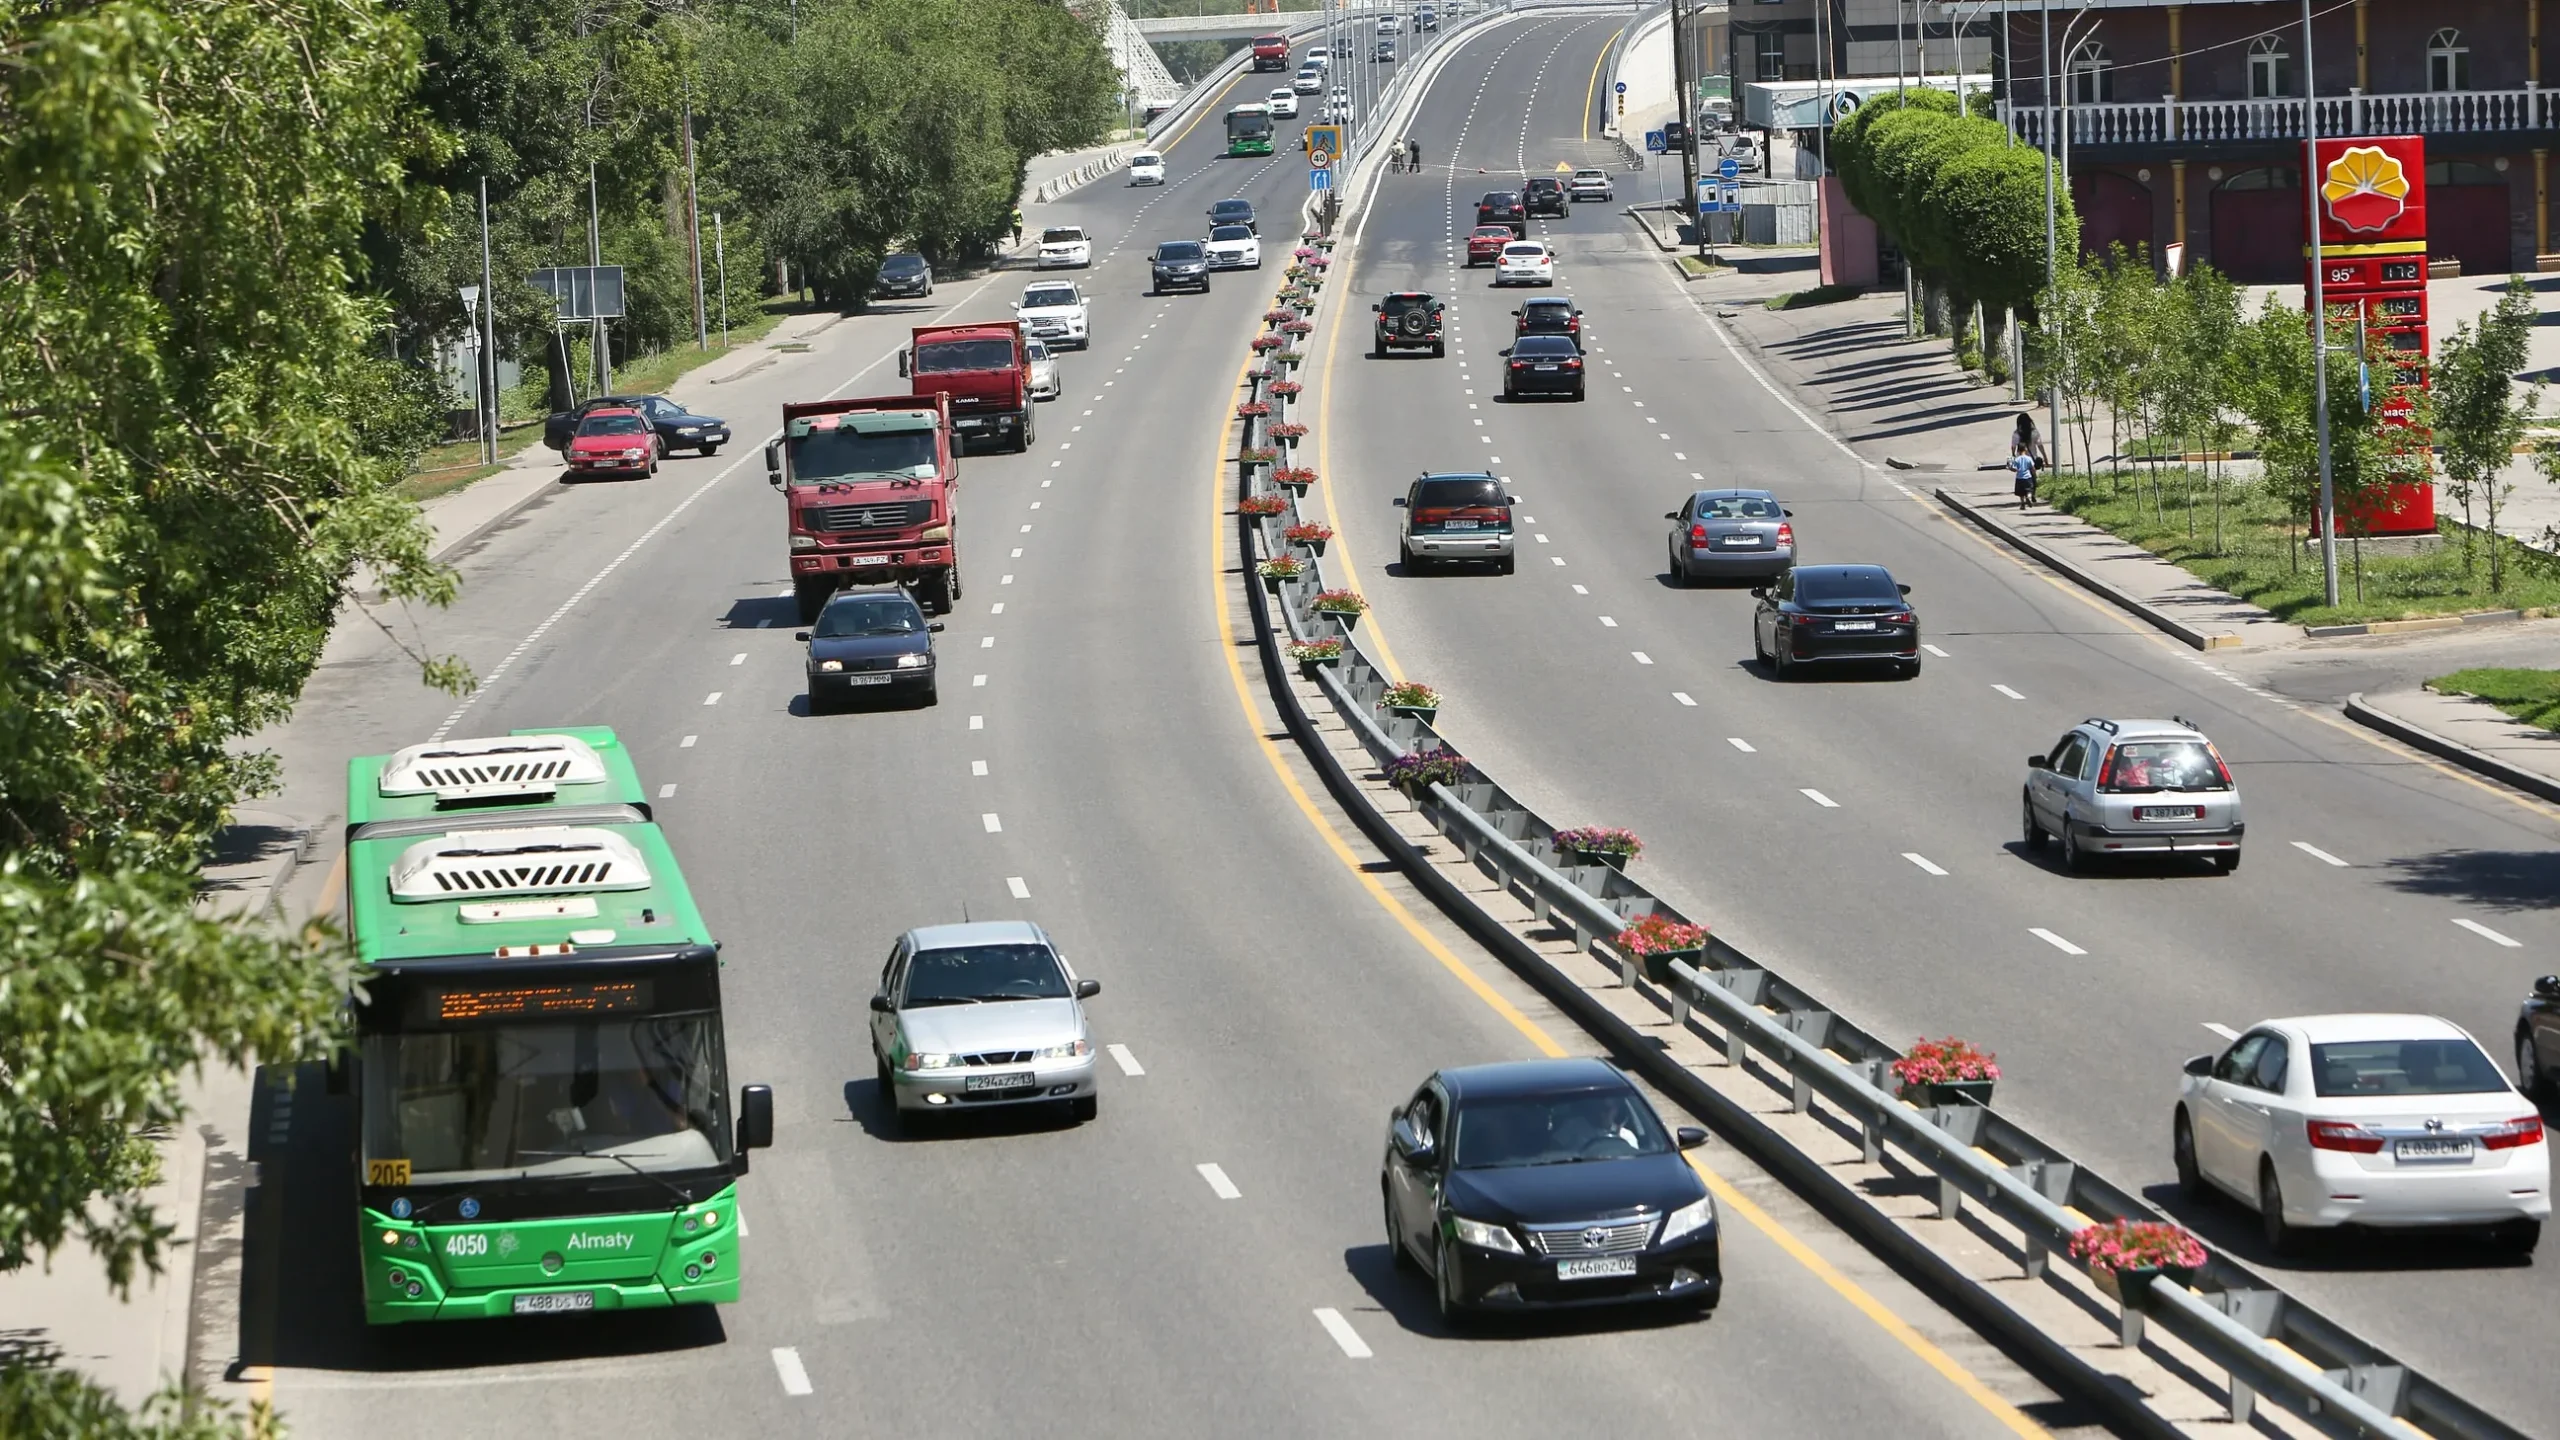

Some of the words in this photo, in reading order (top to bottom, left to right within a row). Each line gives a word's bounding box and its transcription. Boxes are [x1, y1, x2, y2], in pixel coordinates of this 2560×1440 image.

[1313, 154, 1326, 162] 40
[2389, 265, 2416, 278] 172
[372, 1164, 407, 1185] 205
[446, 1234, 488, 1256] 4050
[567, 1232, 635, 1251] Almaty
